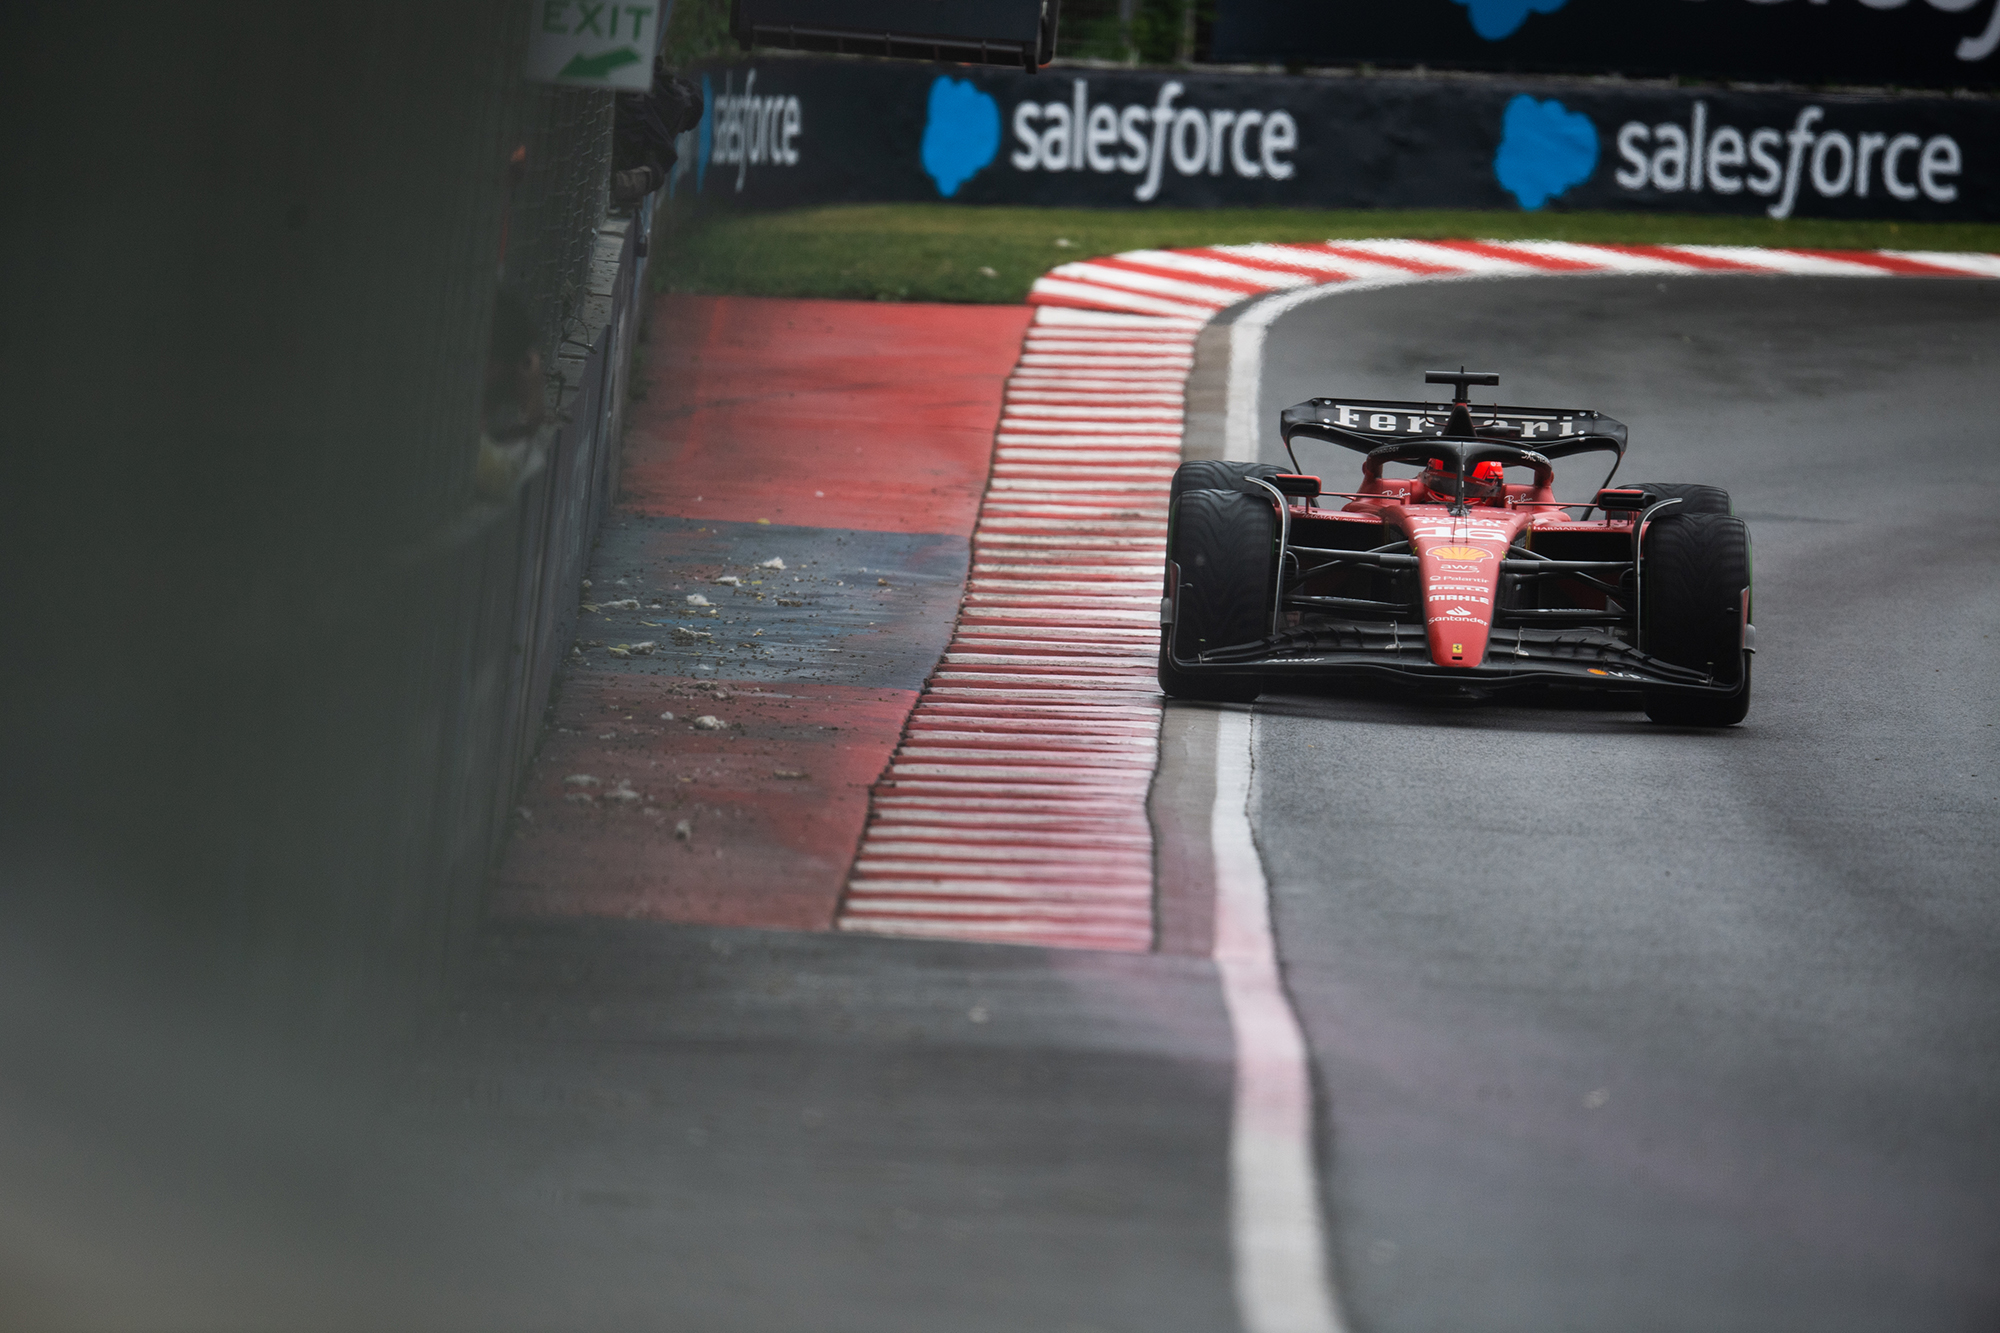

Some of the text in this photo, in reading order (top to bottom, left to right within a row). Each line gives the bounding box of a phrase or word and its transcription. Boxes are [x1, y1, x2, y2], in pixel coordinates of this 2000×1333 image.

[541, 0, 655, 41] EXIT
[1012, 80, 1297, 202] salesforce
[1616, 102, 1962, 219] salesforce
[1334, 405, 1576, 438] Ferri
[1413, 526, 1508, 543] 16
[1443, 575, 1490, 584] Palantir
[1428, 594, 1490, 605] MAHLE
[1428, 616, 1488, 627] Santander
